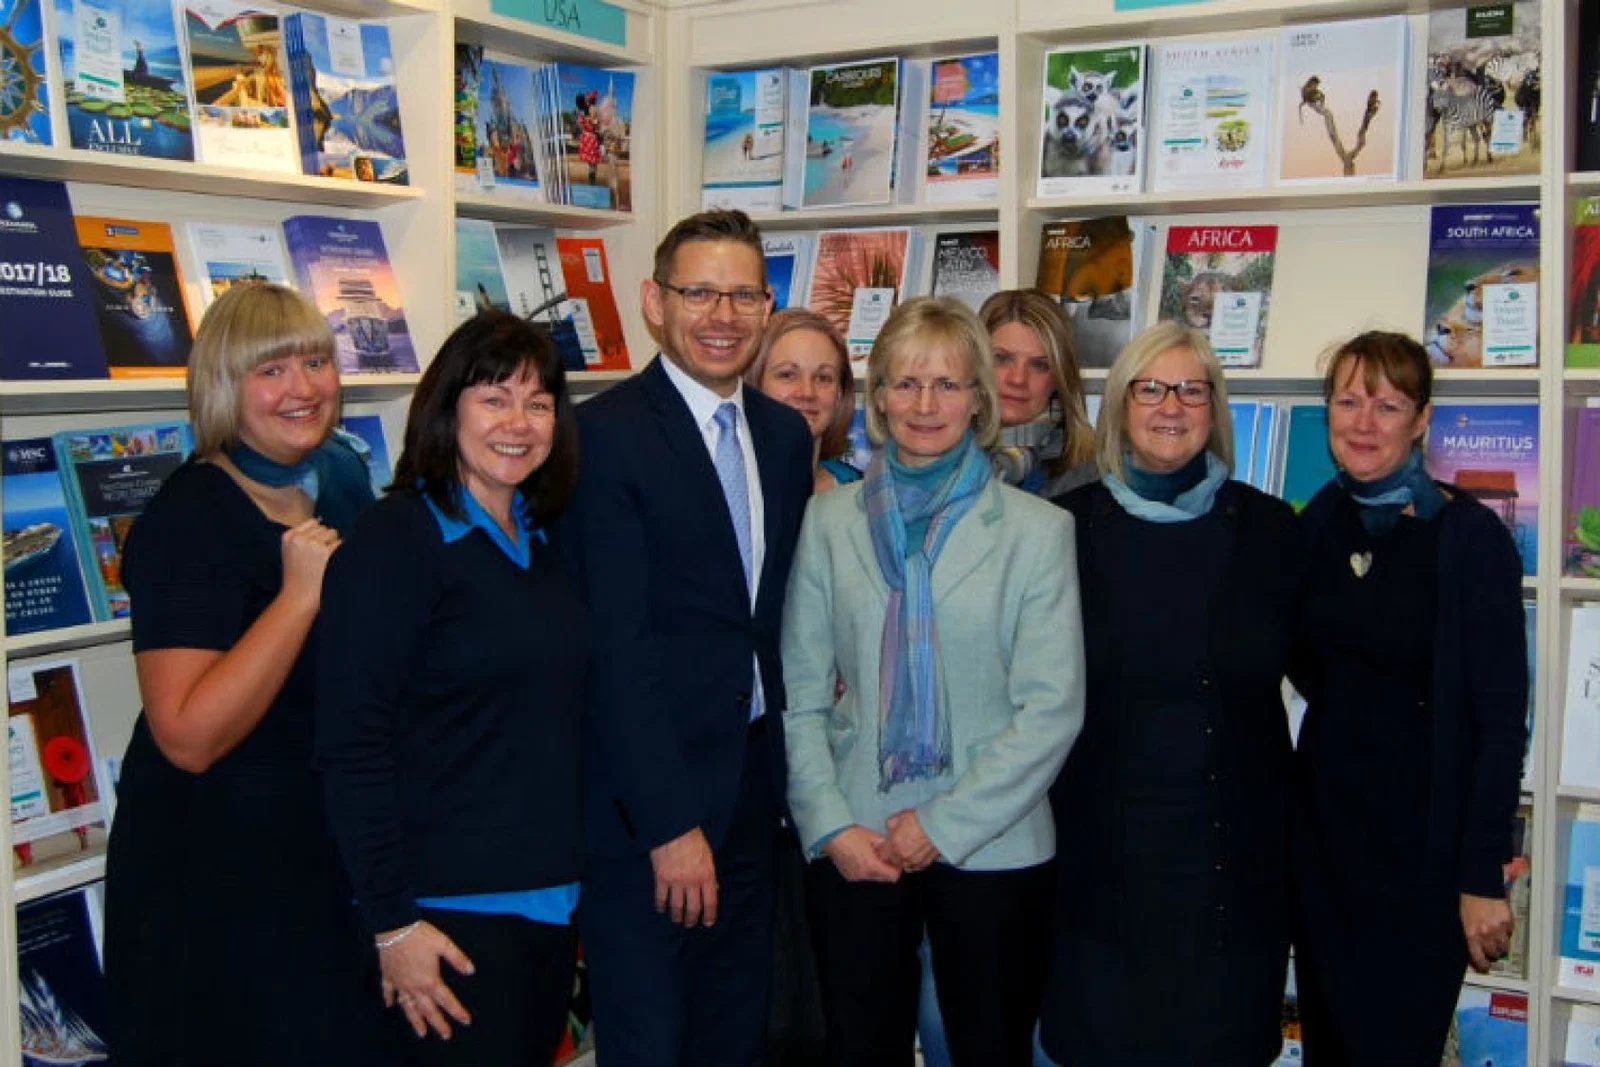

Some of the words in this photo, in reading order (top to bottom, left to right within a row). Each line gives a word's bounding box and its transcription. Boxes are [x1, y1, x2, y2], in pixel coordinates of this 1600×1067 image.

[543, 0, 581, 29] USA
[88, 118, 142, 146] ALL
[1187, 229, 1253, 247] AFRICA
[1446, 227, 1488, 238] SOUTH
[1490, 226, 1535, 238] AFRICA
[1045, 235, 1092, 249] AFRICA
[1443, 434, 1534, 450] MAURITIUS
